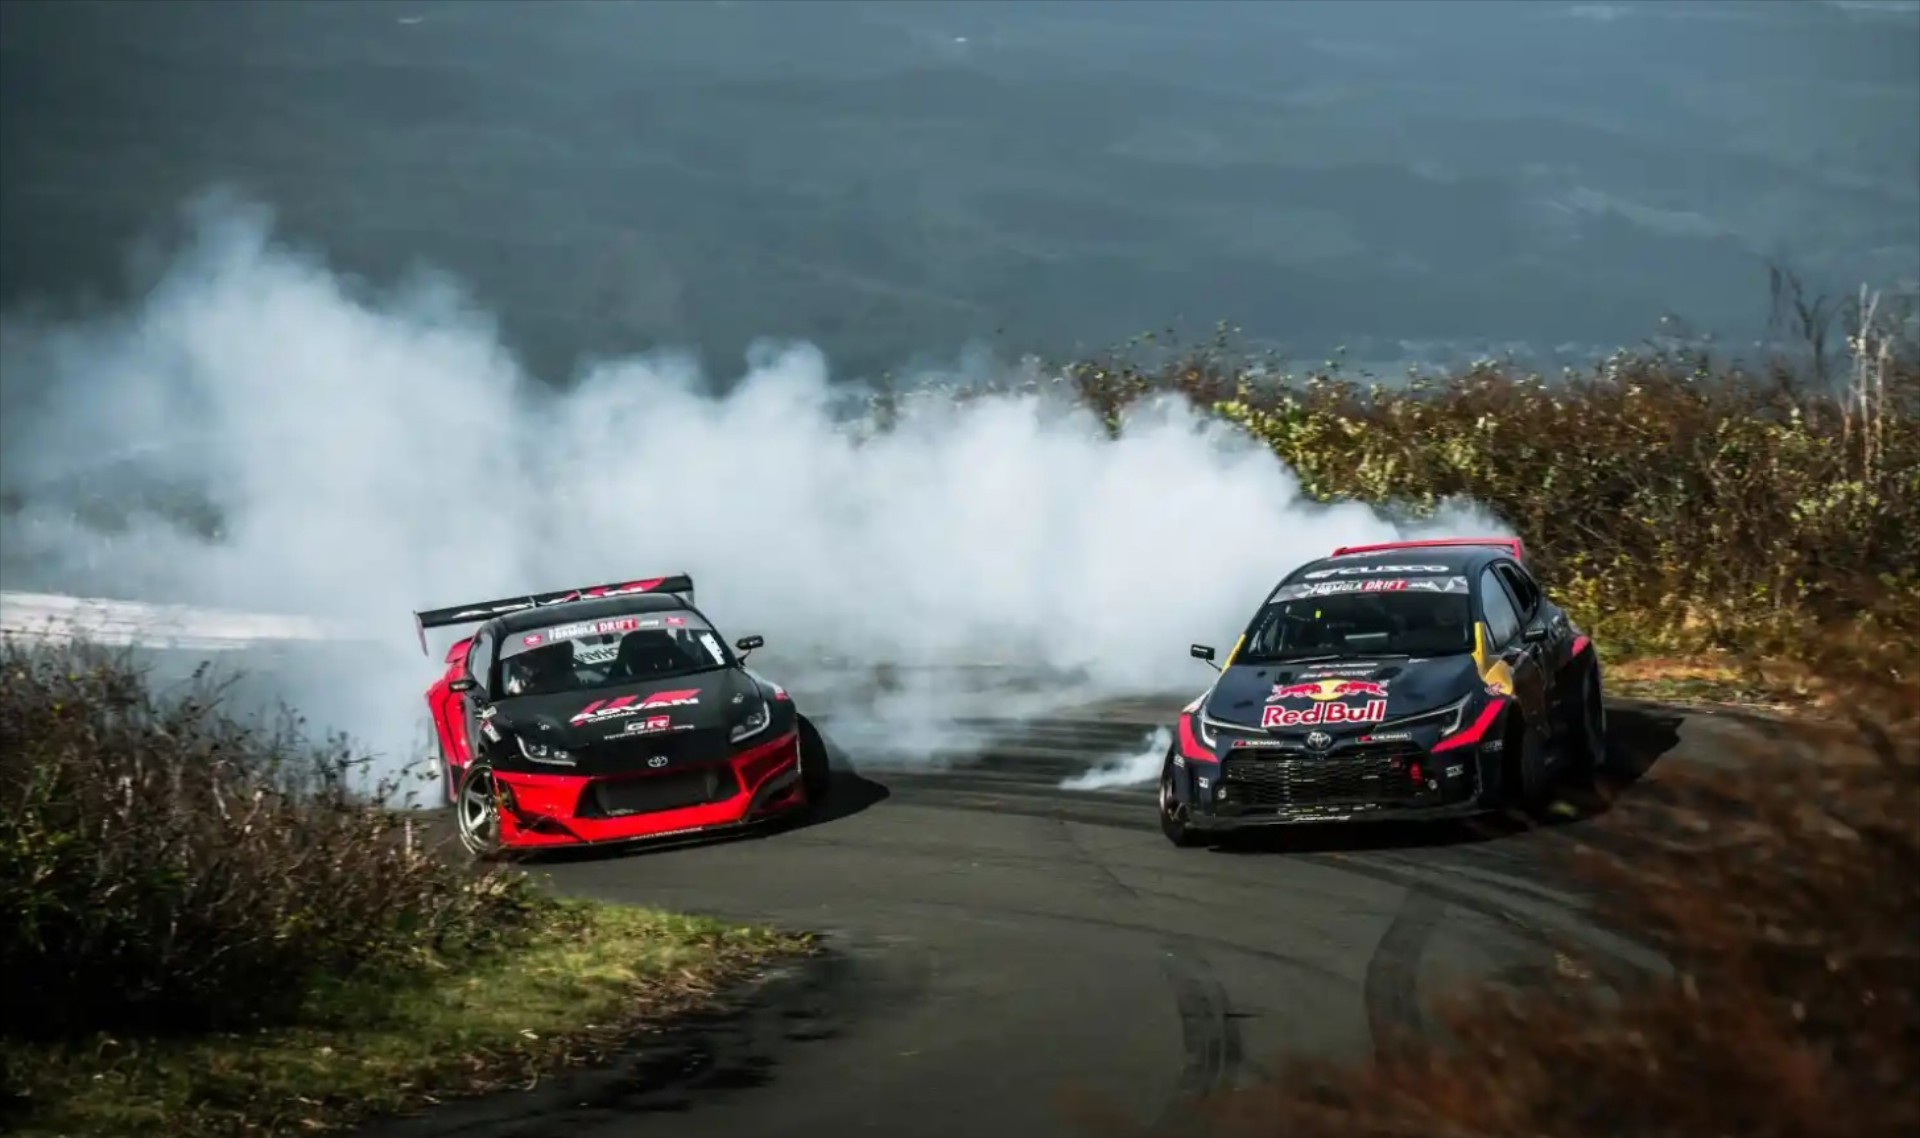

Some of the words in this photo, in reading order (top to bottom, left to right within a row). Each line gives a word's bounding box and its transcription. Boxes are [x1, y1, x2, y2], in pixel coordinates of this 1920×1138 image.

[1364, 579, 1406, 591] DRIFT
[599, 618, 635, 632] DRIFT
[569, 690, 700, 724] ADVAN
[1261, 702, 1324, 728] Red
[1323, 700, 1387, 724] Bull
[627, 720, 669, 731] GR
